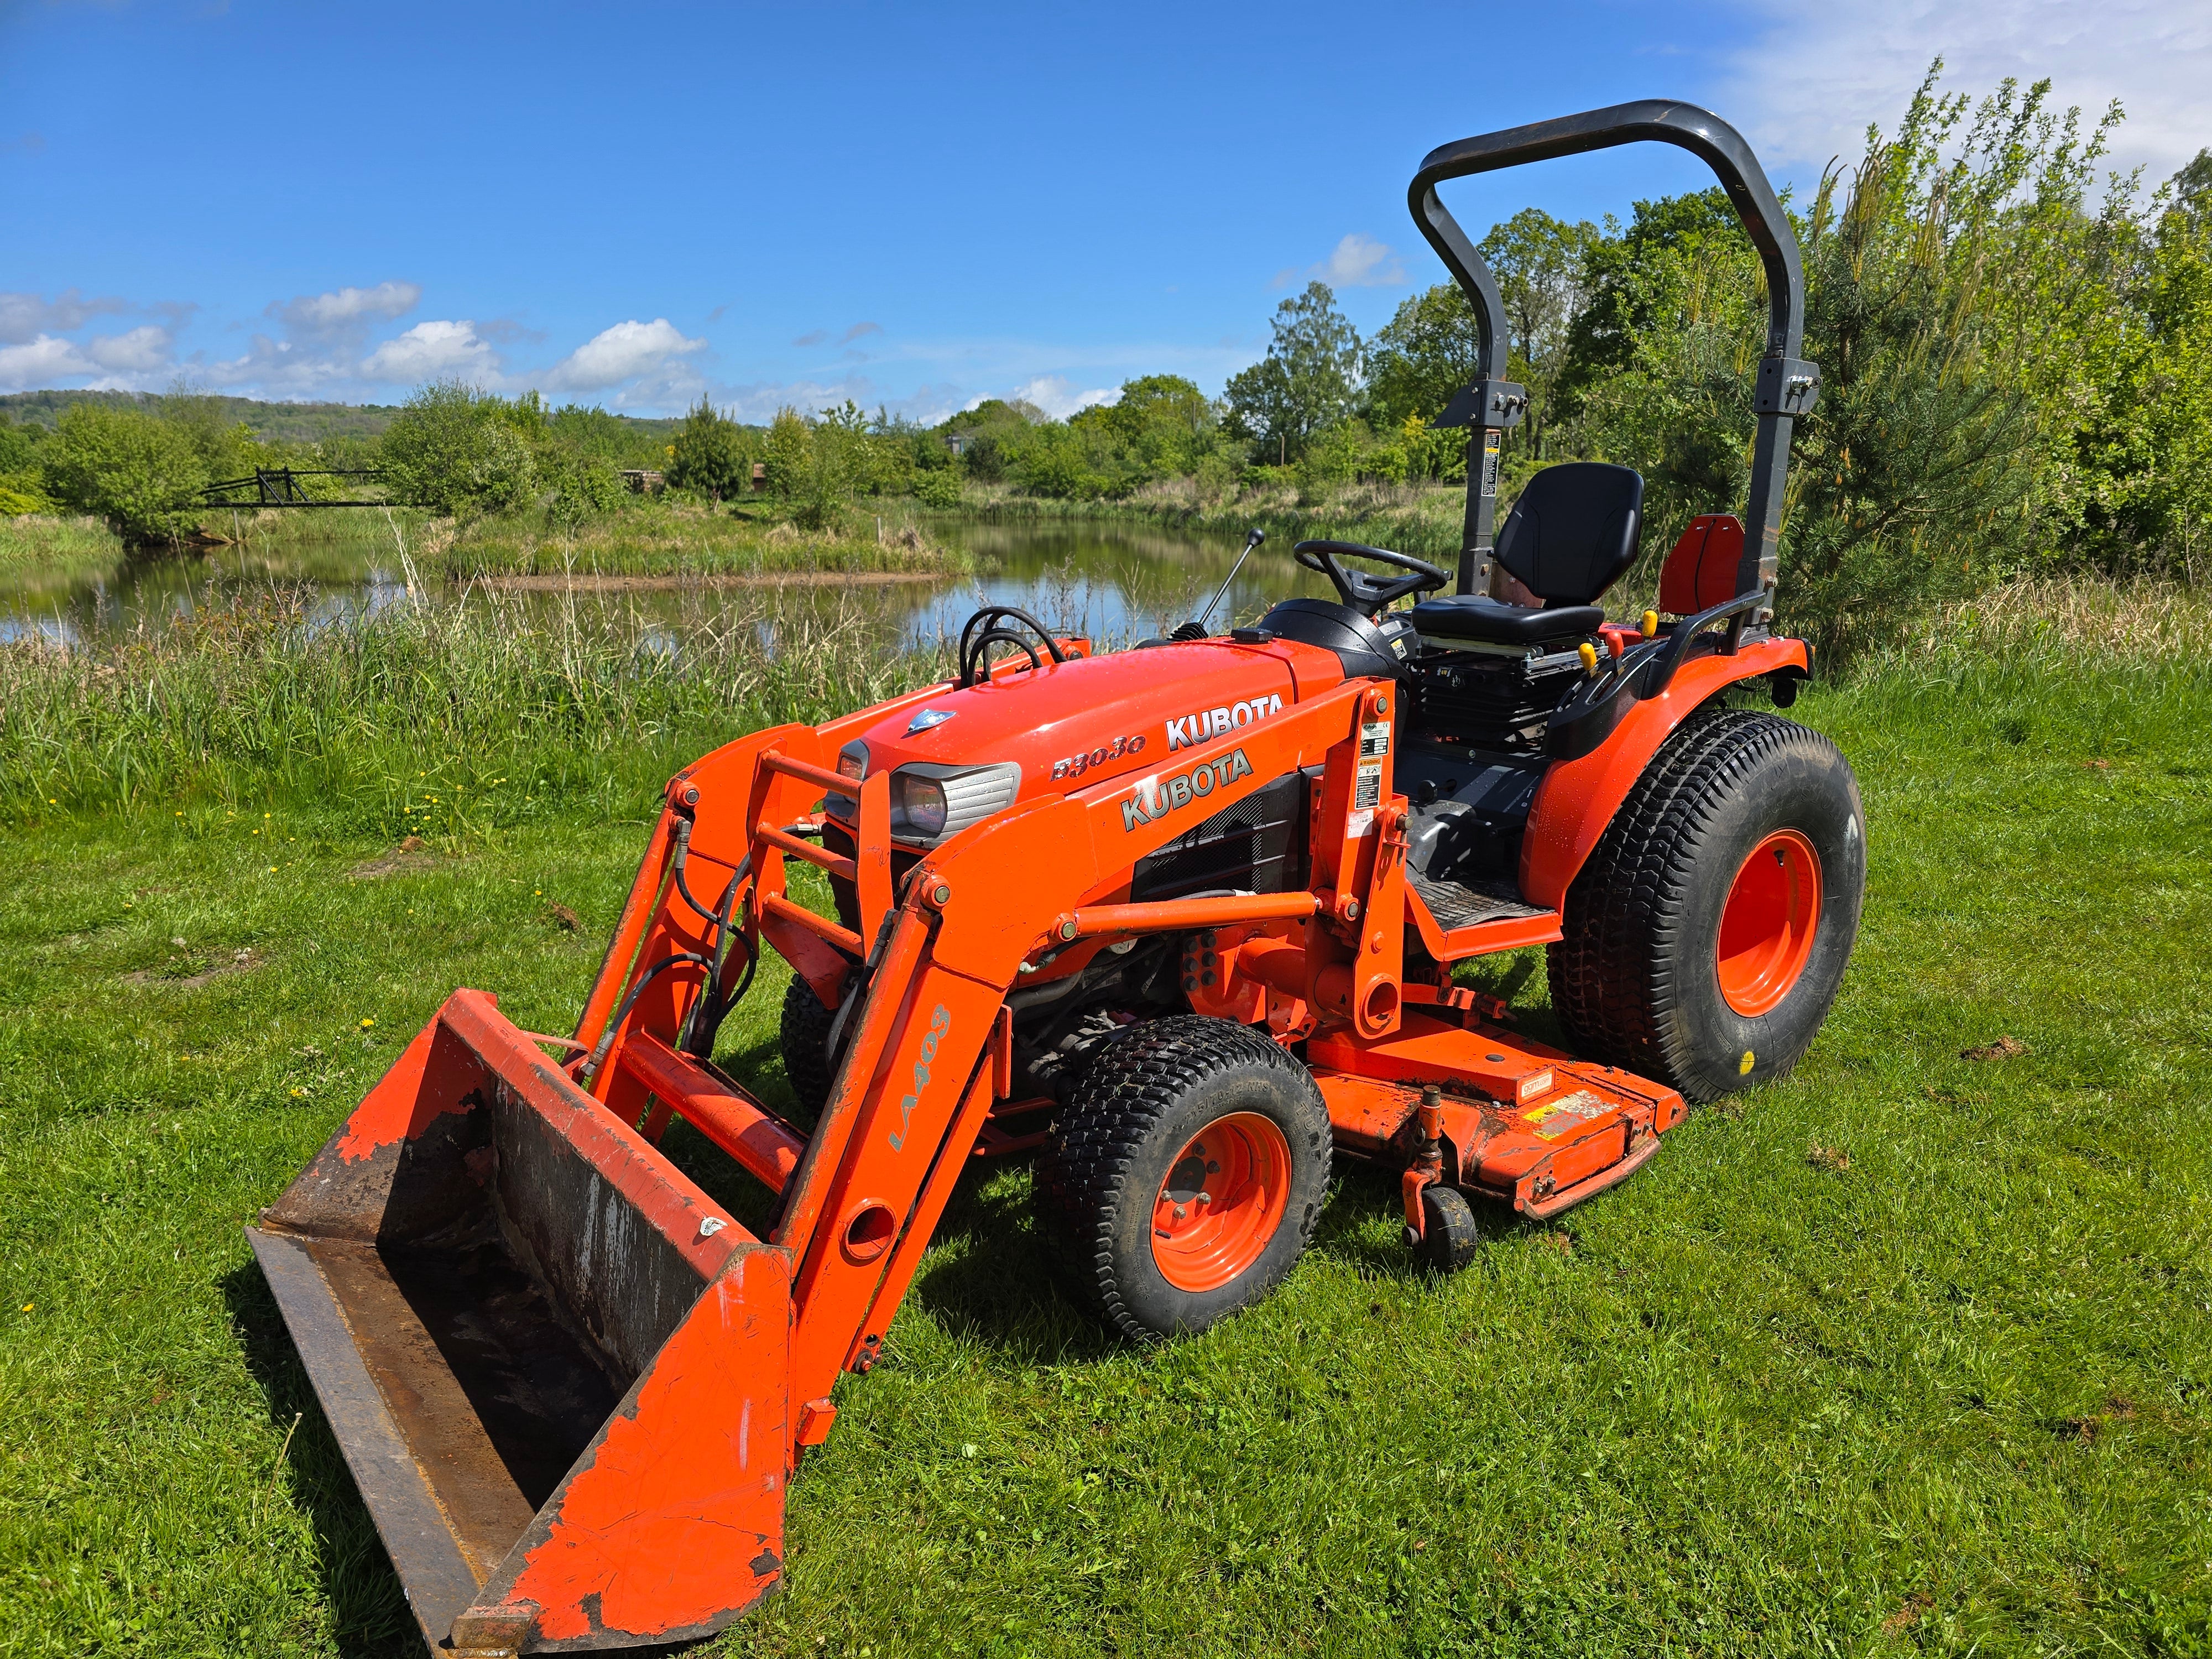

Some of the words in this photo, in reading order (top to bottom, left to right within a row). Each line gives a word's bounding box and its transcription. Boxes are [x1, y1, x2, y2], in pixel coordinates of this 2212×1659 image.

[1166, 694, 1283, 750] KUBOTA
[1051, 736, 1146, 781] B3030
[1121, 748, 1254, 832] KUBOTA
[888, 1003, 951, 1152] LA403
[1247, 1081, 1270, 1093] NHS
[1296, 1102, 1321, 1162] TURF
